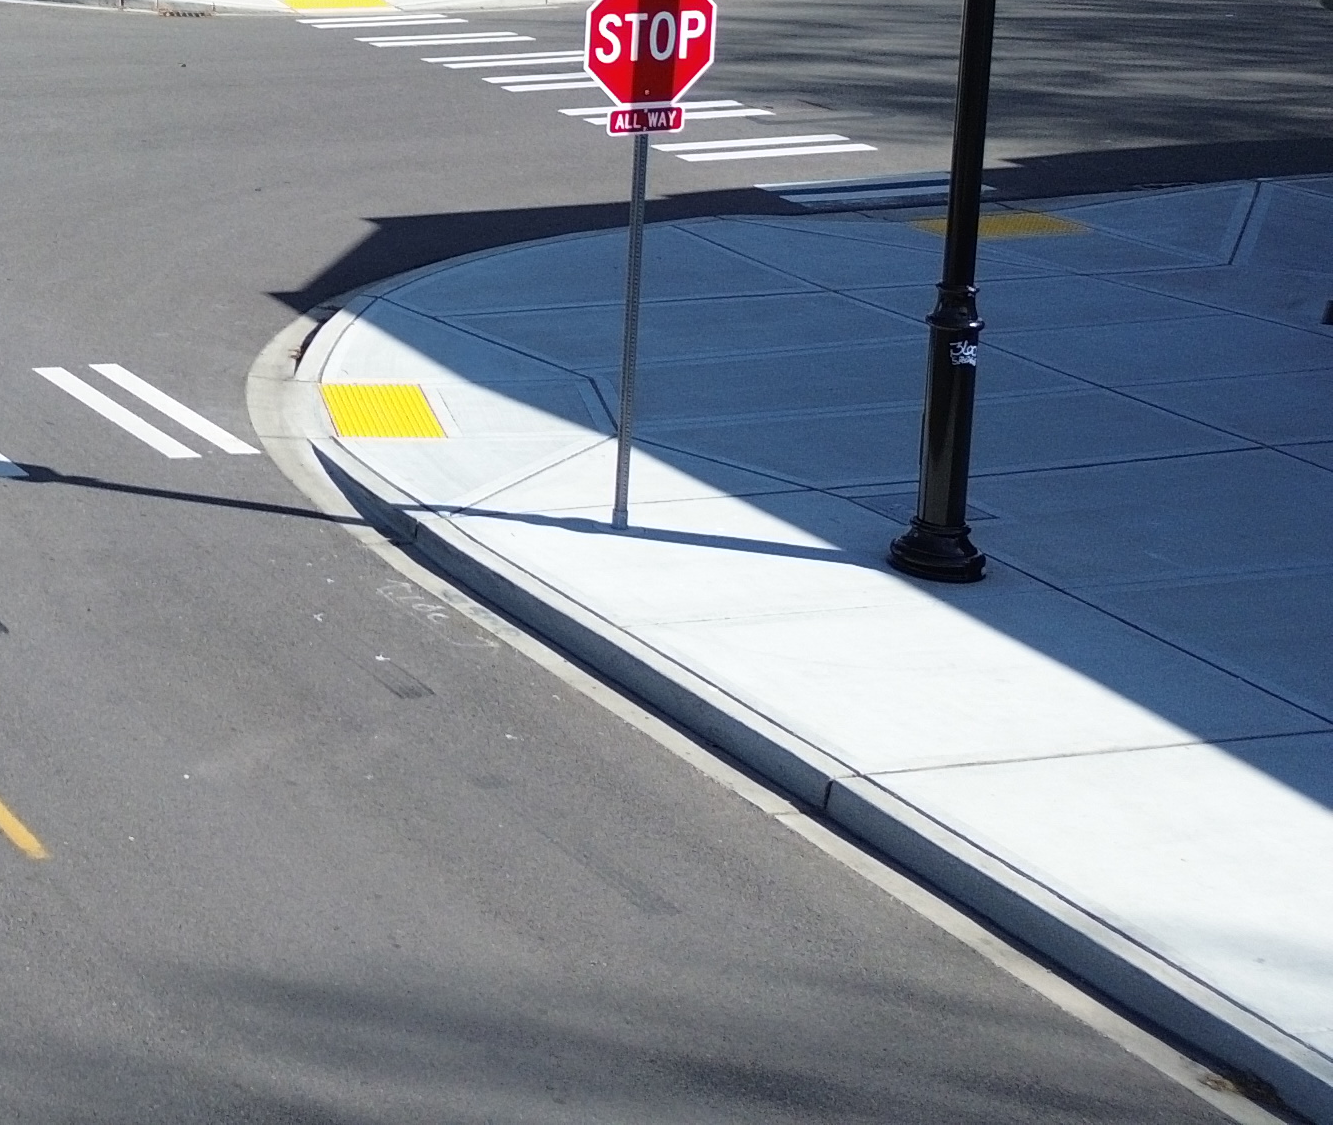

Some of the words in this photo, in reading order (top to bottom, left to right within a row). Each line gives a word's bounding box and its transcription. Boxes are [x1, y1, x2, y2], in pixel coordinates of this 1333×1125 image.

[595, 10, 707, 64] STOP
[614, 112, 641, 130] ALL
[647, 110, 677, 128] WAY
